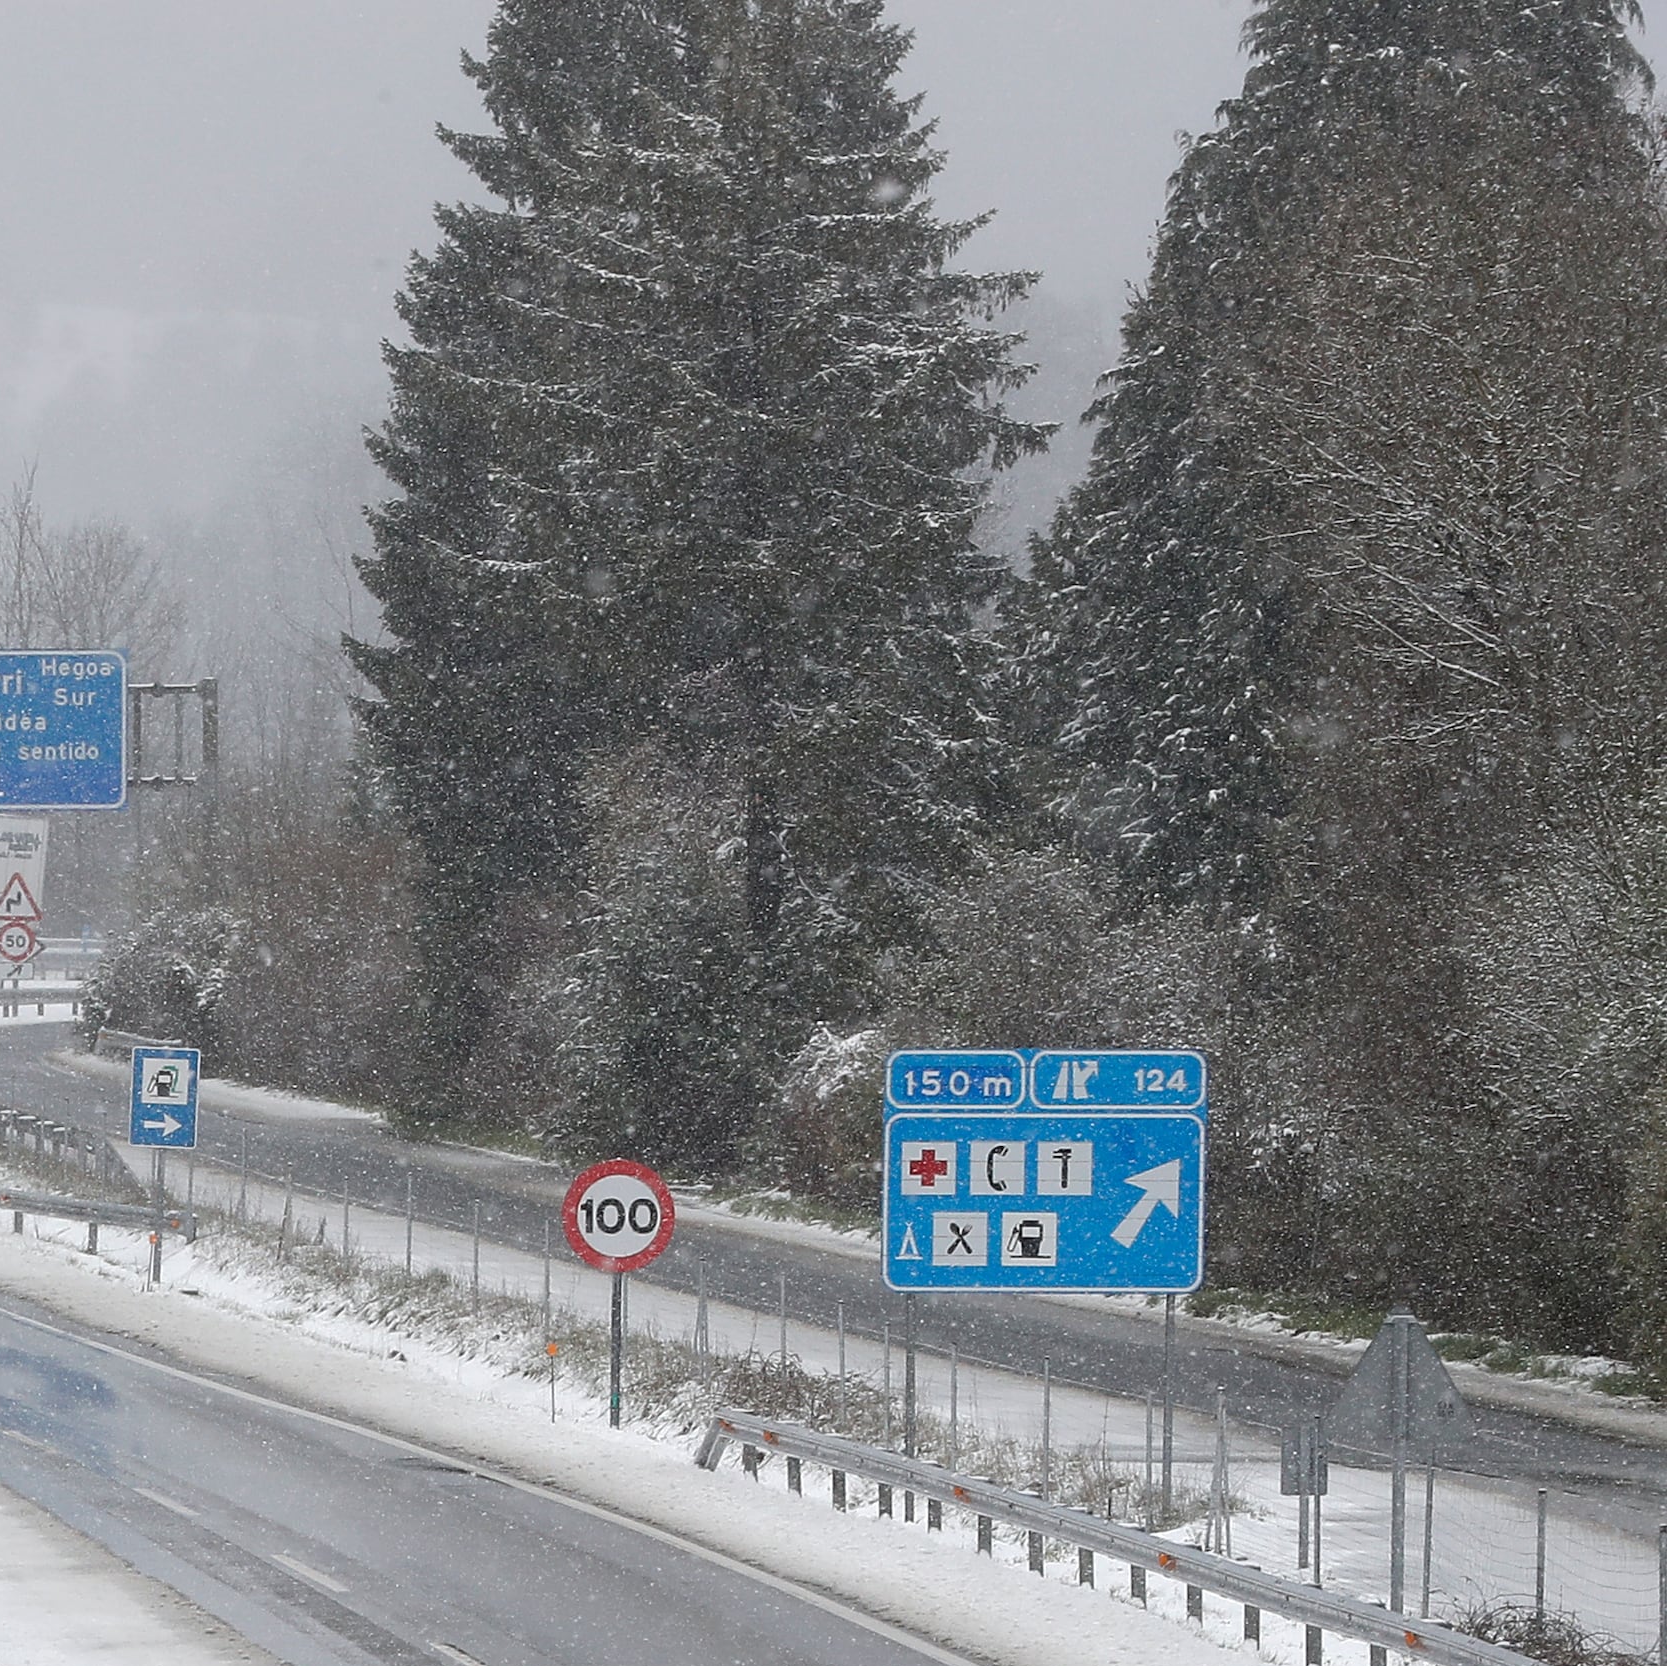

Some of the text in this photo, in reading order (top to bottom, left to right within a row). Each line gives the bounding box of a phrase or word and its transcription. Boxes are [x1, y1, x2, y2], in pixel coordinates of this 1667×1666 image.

[42, 659, 112, 681] Hegoa
[54, 688, 97, 706] Sur
[17, 741, 100, 762] sentido
[5, 934, 27, 949] 50
[903, 1070, 1013, 1097] 150 m
[1134, 1068, 1188, 1093] 124
[580, 1198, 659, 1234] 100
